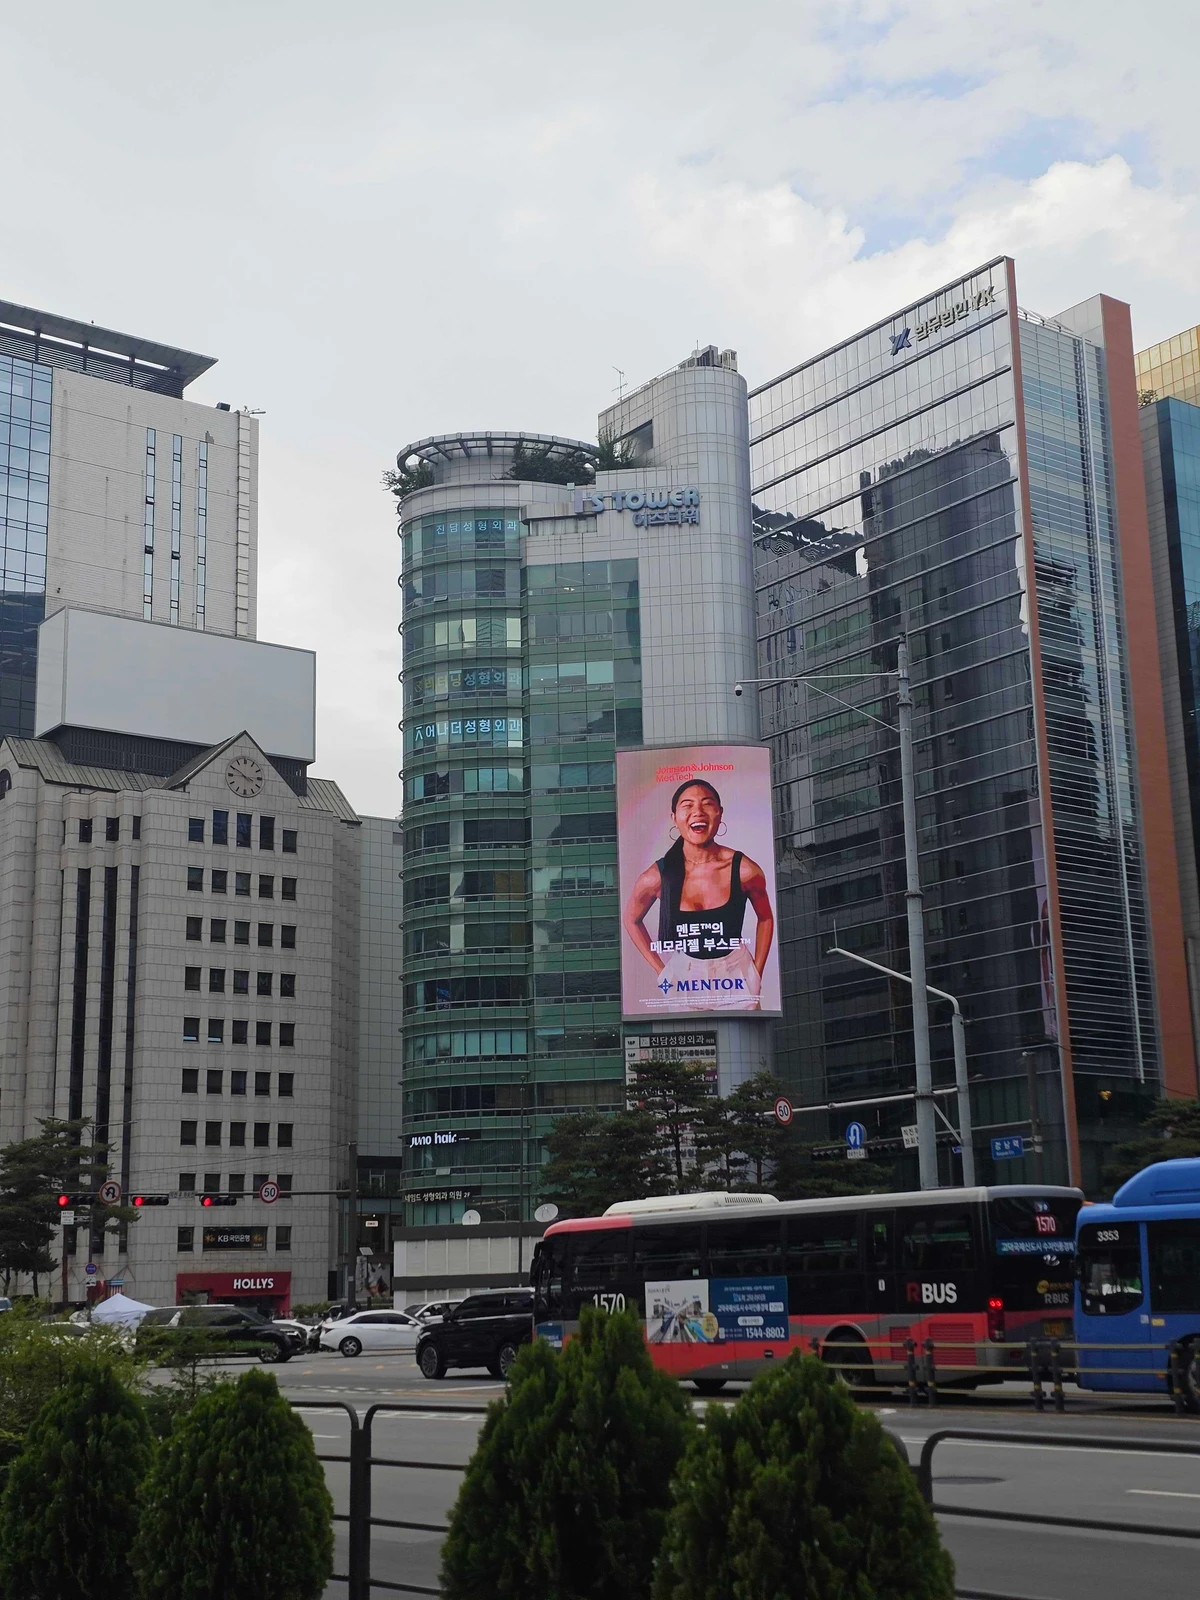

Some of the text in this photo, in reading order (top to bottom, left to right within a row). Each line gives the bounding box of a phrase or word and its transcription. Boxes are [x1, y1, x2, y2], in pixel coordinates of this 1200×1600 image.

[612, 486, 700, 512] TOWER
[436, 520, 517, 535] 진담성형외과
[656, 763, 734, 775] Johnson&Johnson
[656, 773, 694, 782] MedTech
[650, 938, 700, 954] 메모리젤
[651, 1035, 705, 1046] 진담성형외과
[778, 1105, 789, 1117] 50
[409, 1135, 432, 1148] juno
[264, 1187, 276, 1198] 50
[423, 1191, 448, 1202] 성형외과
[449, 1190, 463, 1200] 의원
[1036, 1216, 1057, 1232] 1570
[1097, 1230, 1120, 1242] 3353
[233, 1278, 274, 1289] HOLLYS
[592, 1292, 625, 1316] 1570
[745, 1326, 786, 1339] 1544-8802
